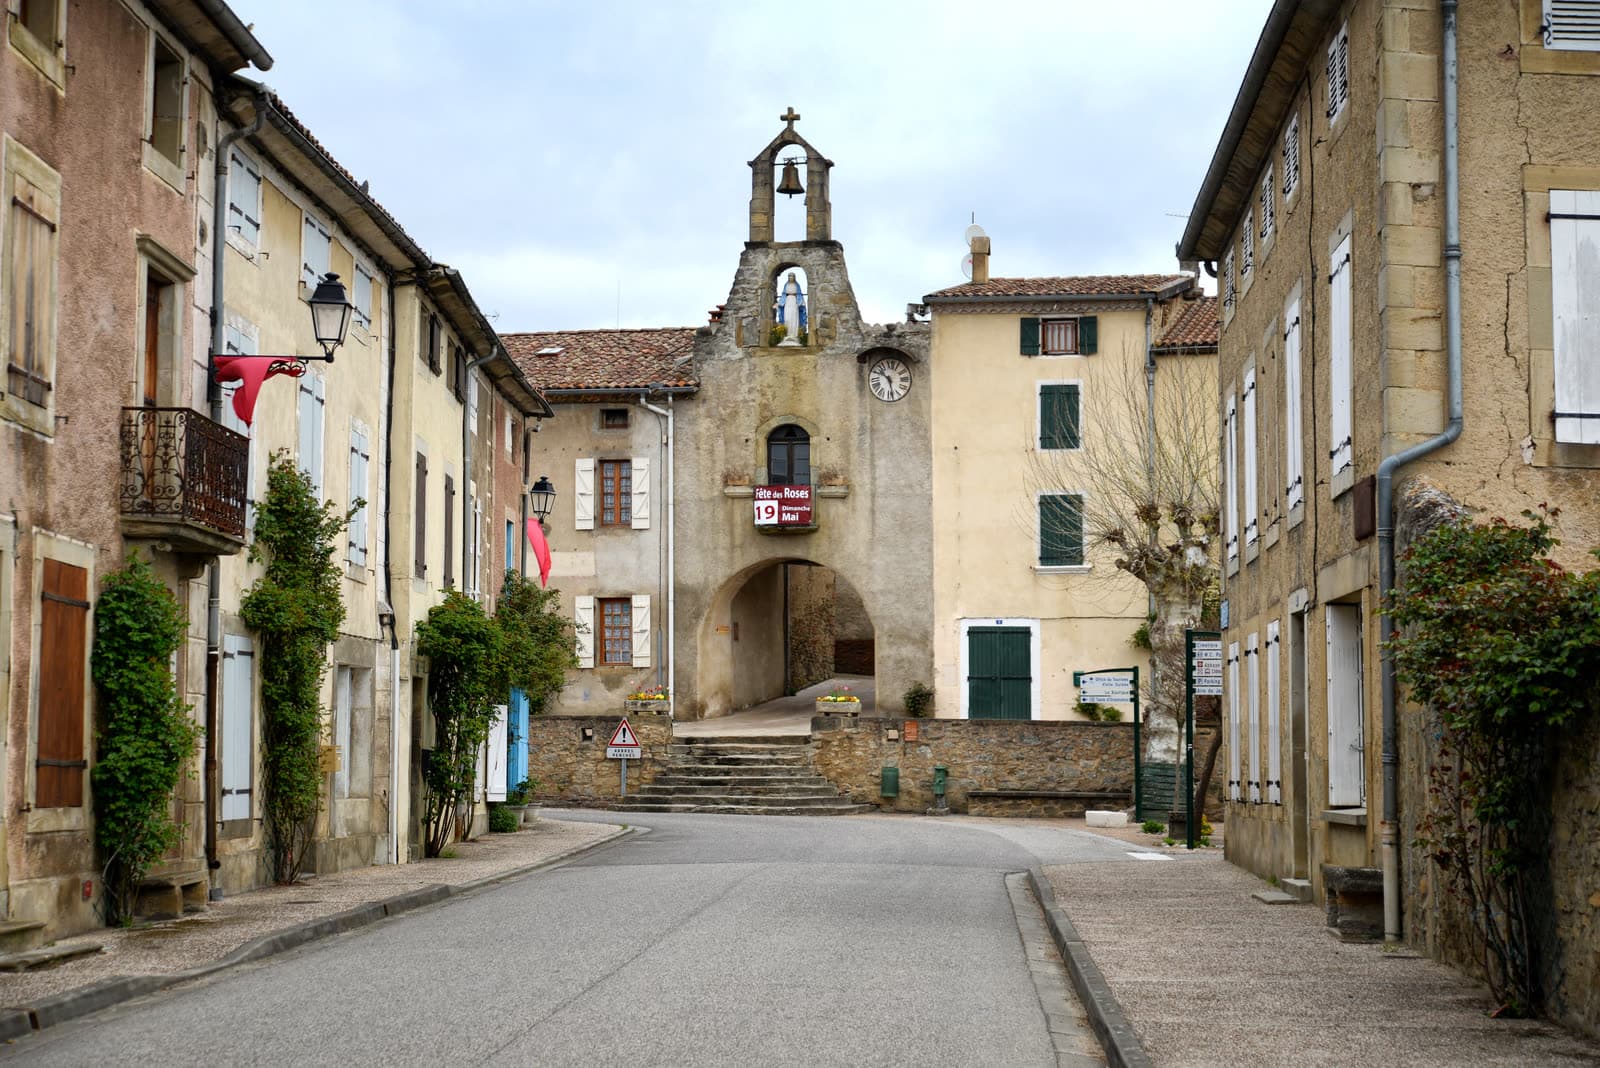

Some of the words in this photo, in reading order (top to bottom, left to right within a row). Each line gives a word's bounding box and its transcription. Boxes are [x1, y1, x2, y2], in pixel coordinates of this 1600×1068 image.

[755, 487, 771, 499] Fête
[784, 487, 809, 499] Roses
[755, 505, 776, 520] 19
[782, 512, 799, 521] Mai
